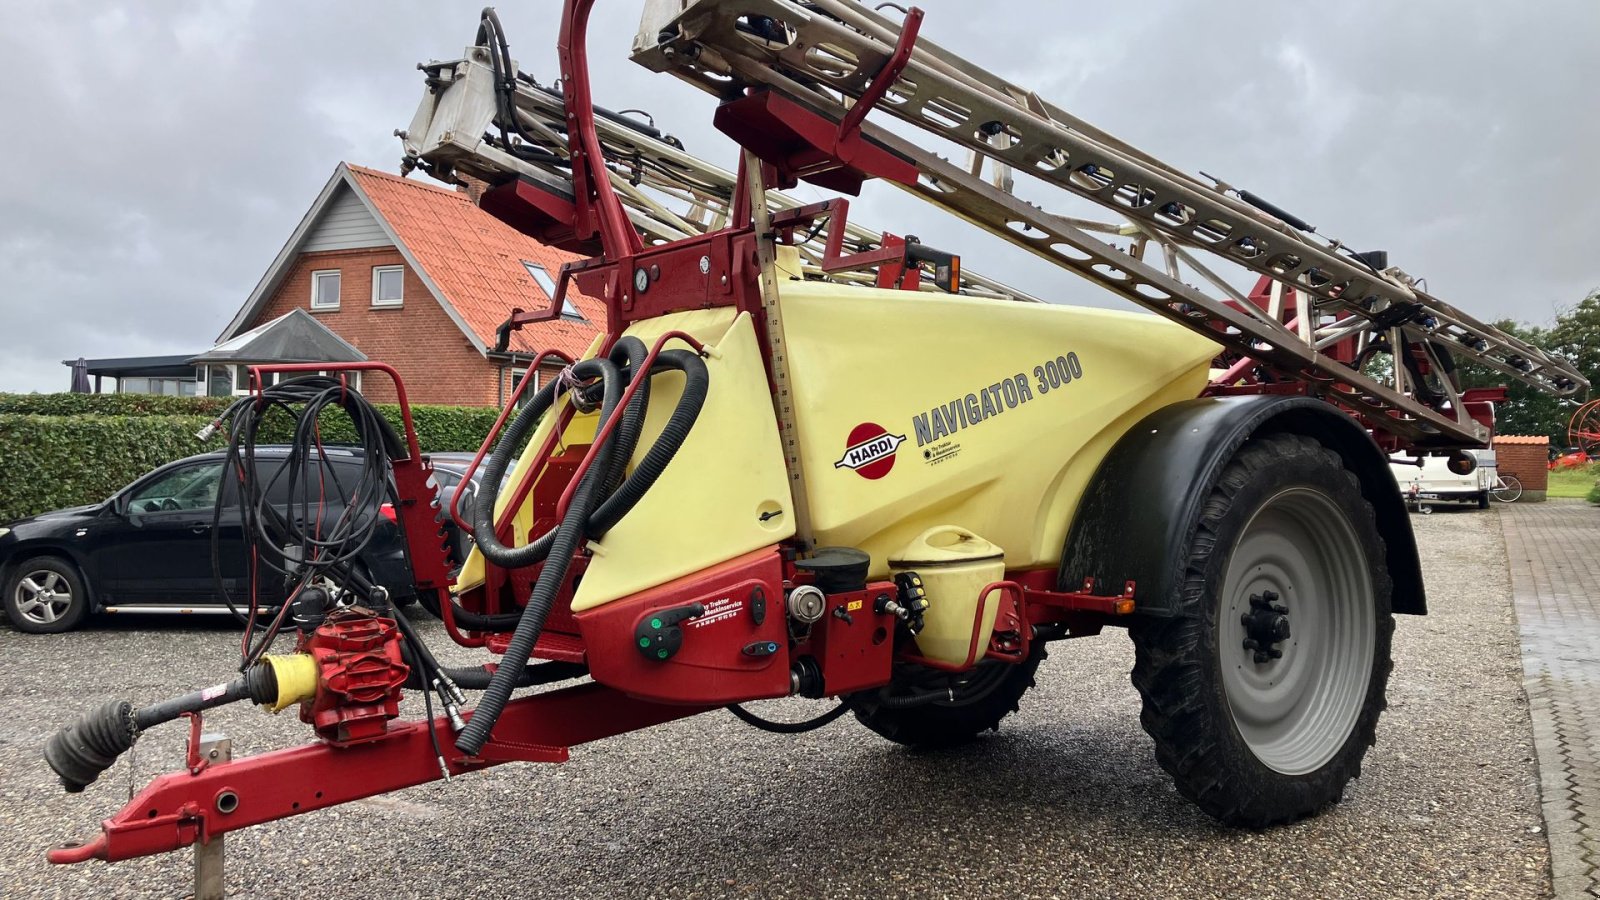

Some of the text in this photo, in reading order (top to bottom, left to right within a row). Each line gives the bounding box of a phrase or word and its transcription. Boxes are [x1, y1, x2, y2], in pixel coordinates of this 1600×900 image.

[912, 351, 1083, 447] NAVIGATOR 3000
[850, 437, 893, 465] HARDI
[704, 600, 742, 616] Maskinservice
[710, 598, 730, 608] Traktor
